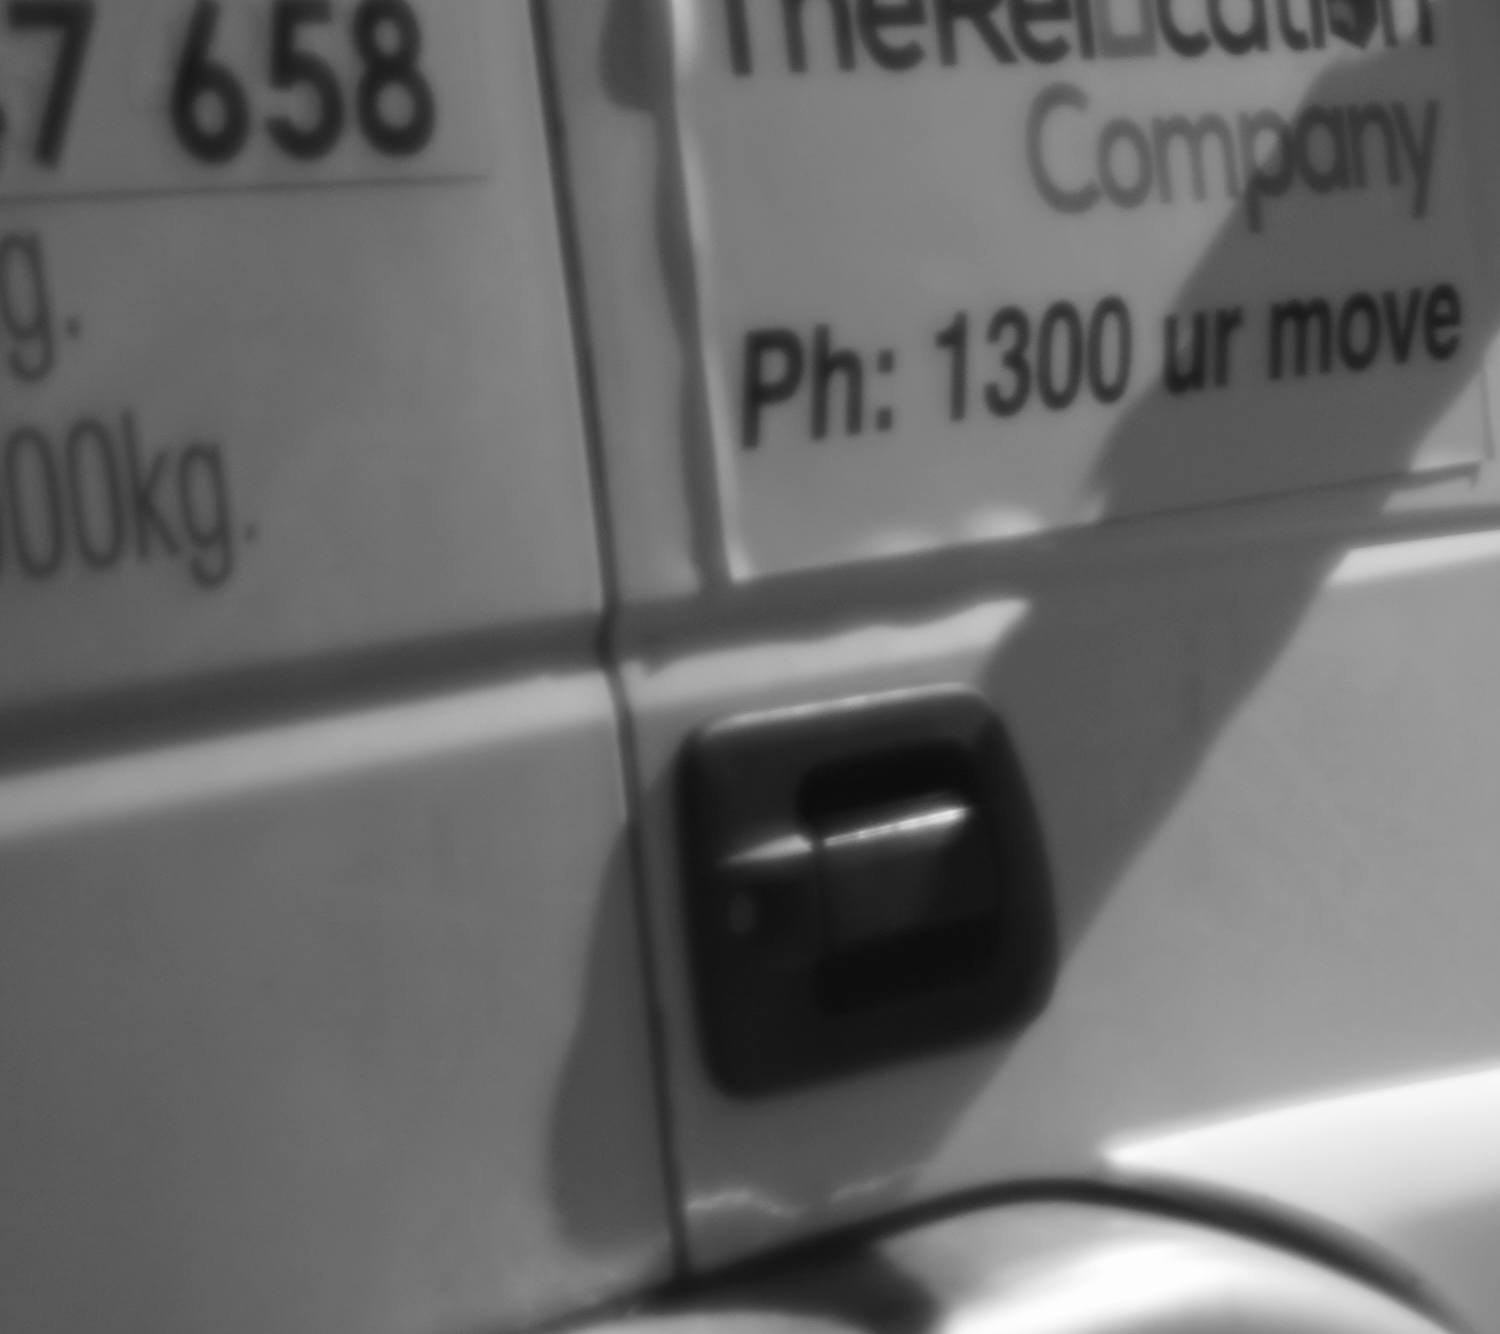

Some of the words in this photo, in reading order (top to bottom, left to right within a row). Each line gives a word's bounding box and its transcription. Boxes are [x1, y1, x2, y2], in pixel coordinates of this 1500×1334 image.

[1026, 80, 1441, 235] Company
[740, 322, 895, 451] Ph:
[934, 293, 1133, 423] 1300
[1162, 303, 1243, 395] ur
[1268, 280, 1462, 382] move
